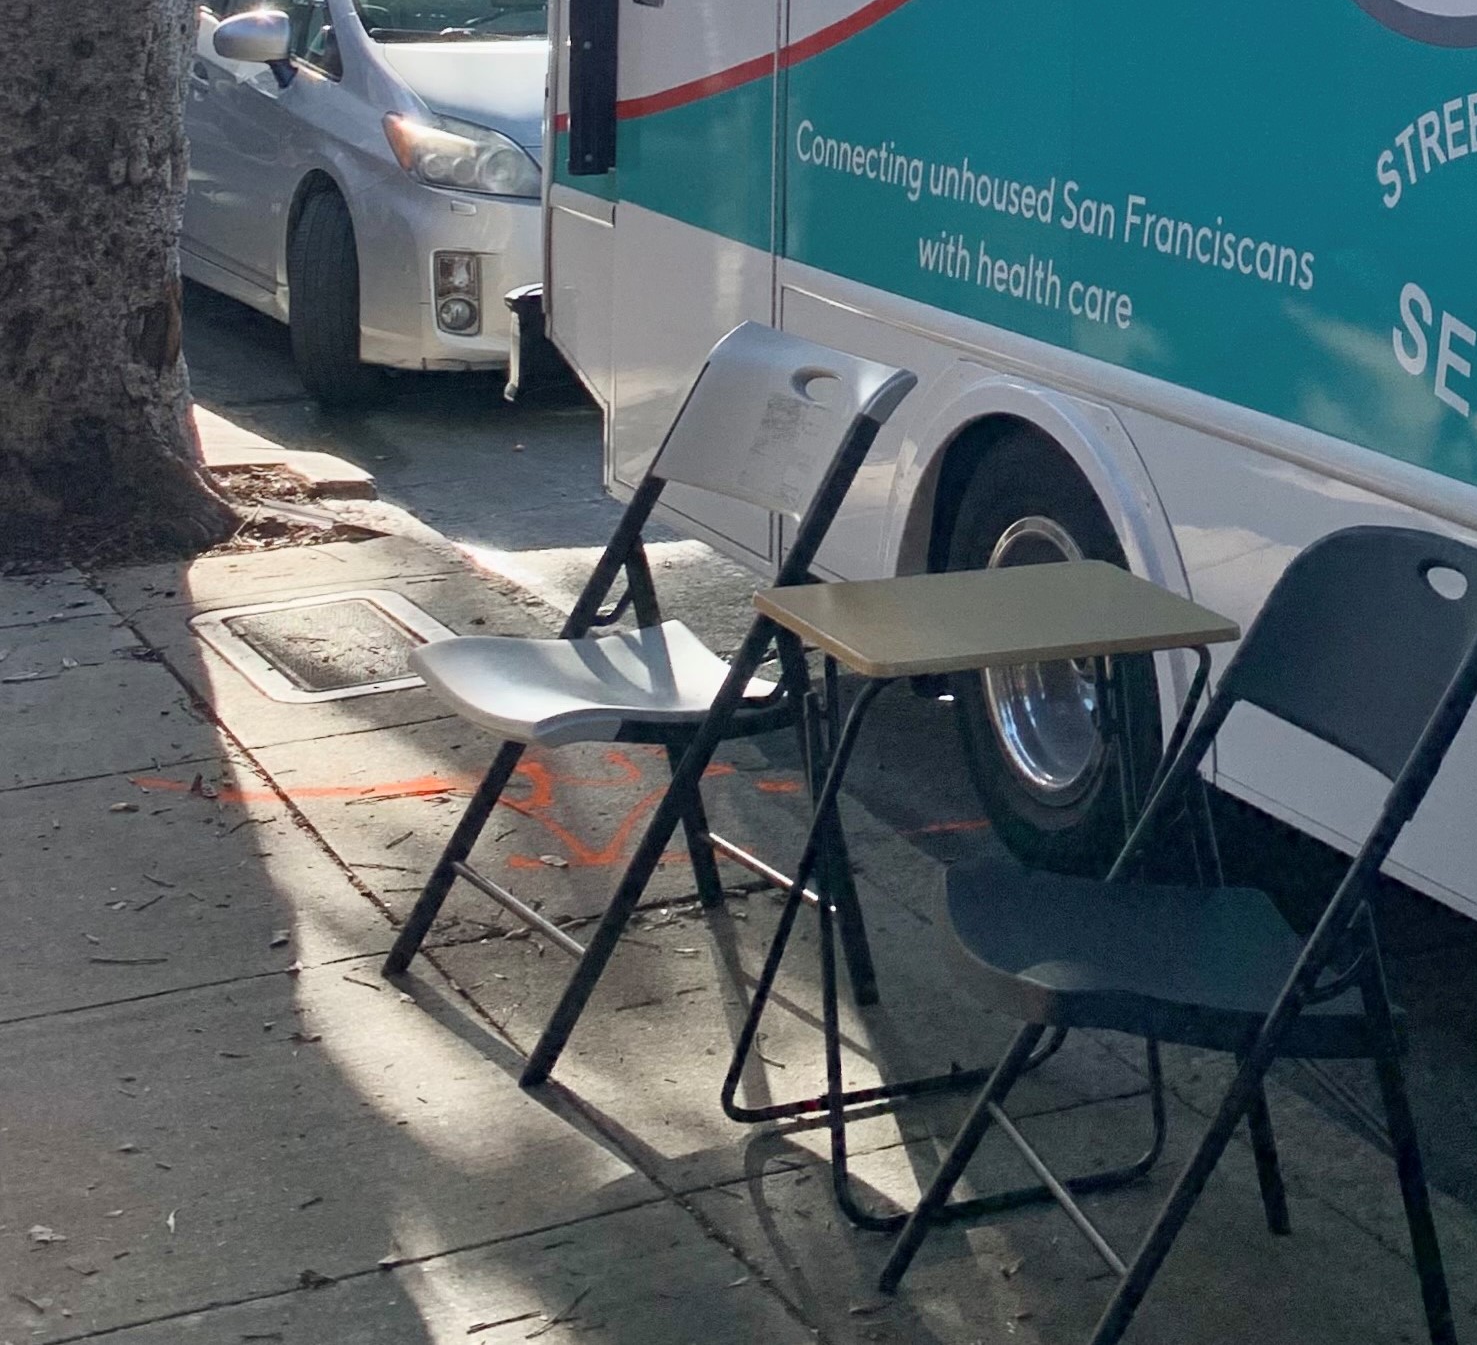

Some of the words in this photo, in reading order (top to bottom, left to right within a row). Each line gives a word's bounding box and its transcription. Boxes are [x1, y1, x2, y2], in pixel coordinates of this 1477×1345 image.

[796, 119, 924, 202] Connecting
[929, 156, 1056, 224] unhoused
[1060, 180, 1115, 240] San
[1124, 194, 1315, 291] Franciscans
[918, 230, 970, 282] with
[976, 253, 1061, 310] health
[1067, 276, 1134, 330] care
